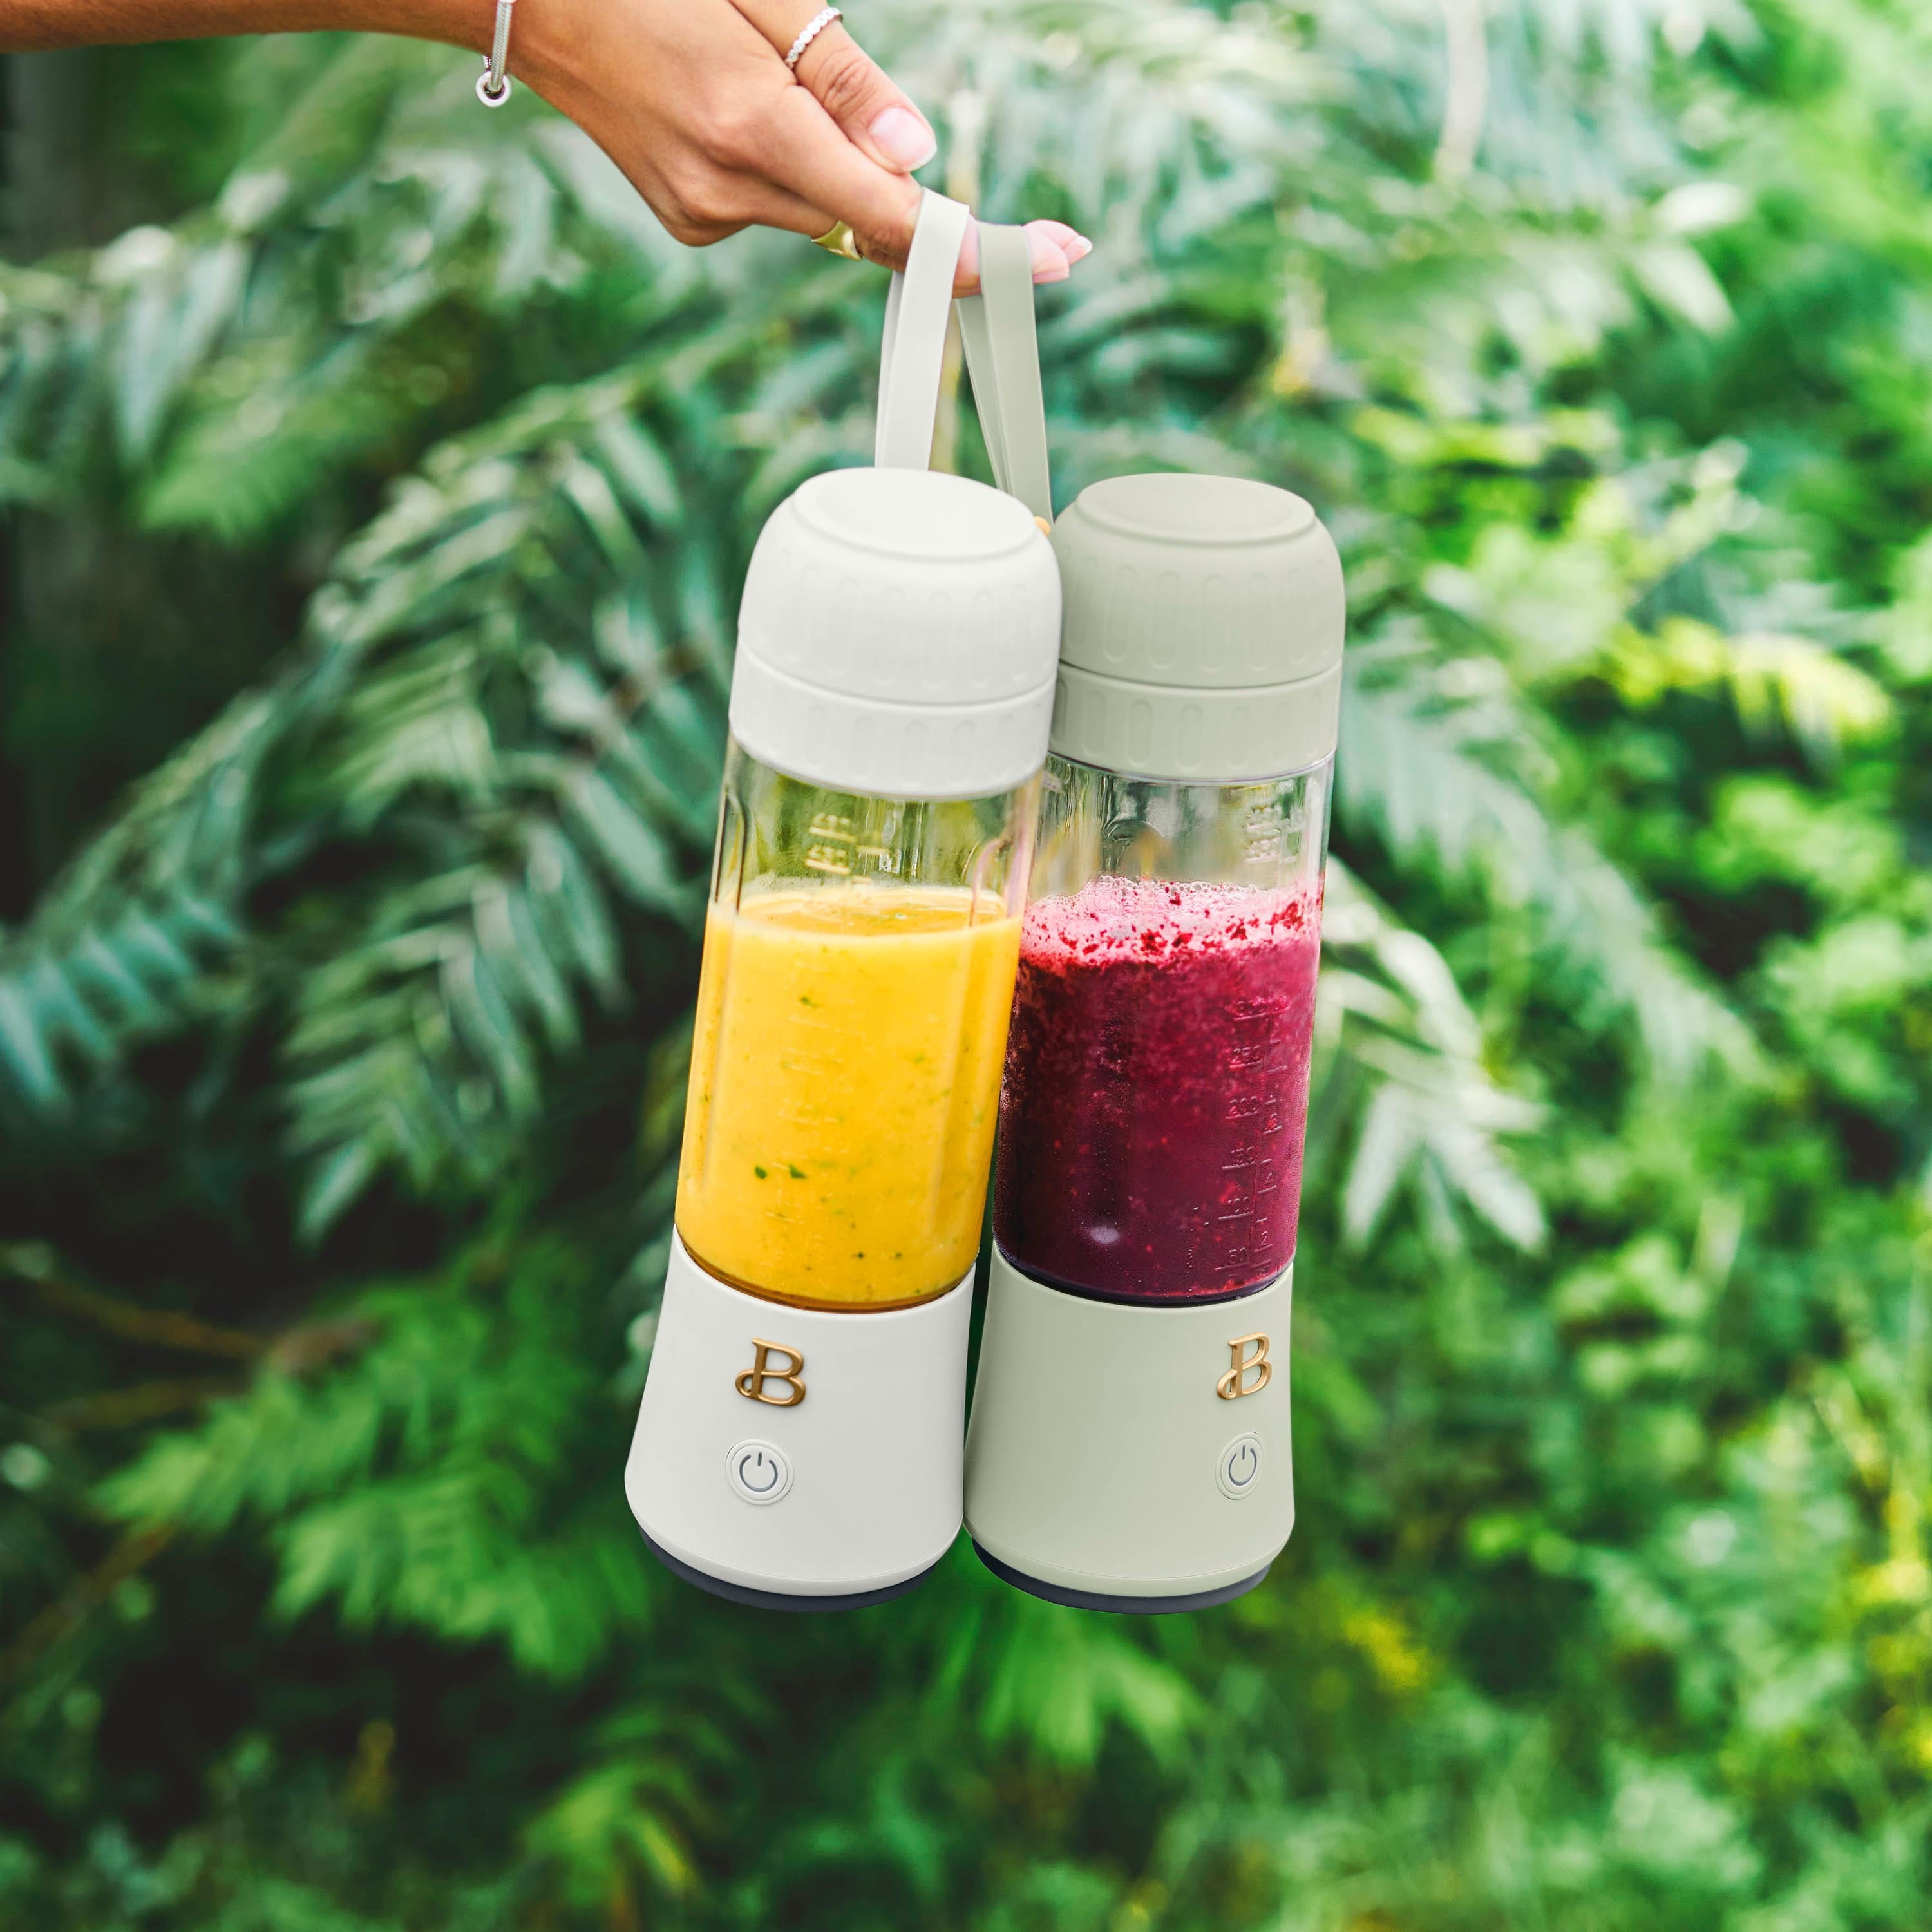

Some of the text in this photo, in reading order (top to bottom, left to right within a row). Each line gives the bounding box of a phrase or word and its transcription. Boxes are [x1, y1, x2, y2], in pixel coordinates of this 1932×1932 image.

[1232, 1045, 1261, 1063] 250
[1227, 1095, 1258, 1115] 200
[1260, 1231, 1269, 1246] 2
[1227, 1247, 1248, 1264] 50
[735, 1337, 806, 1407] B
[1217, 1331, 1273, 1401] B
